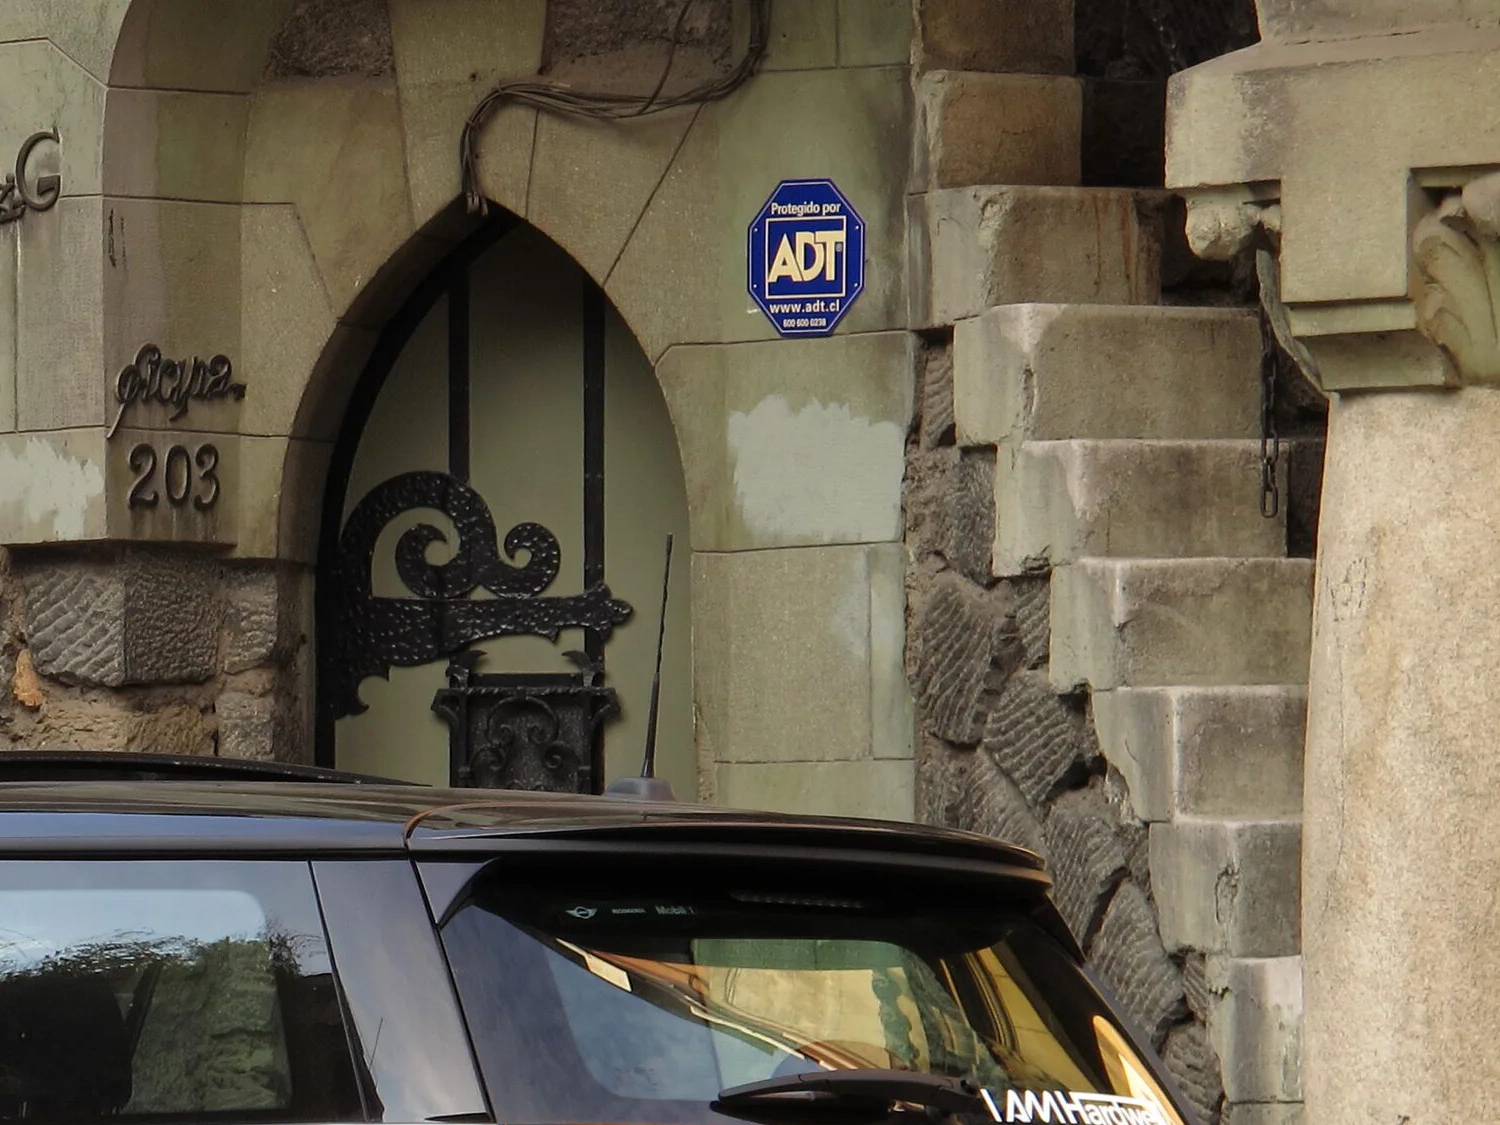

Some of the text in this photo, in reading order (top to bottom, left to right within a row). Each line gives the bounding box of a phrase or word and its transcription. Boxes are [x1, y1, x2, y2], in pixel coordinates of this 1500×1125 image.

[770, 201, 842, 217] Protegido por
[767, 230, 845, 283] ADT
[769, 299, 840, 314] www.adt.cl
[127, 443, 220, 511] 203
[979, 1088, 1003, 1124] I
[1005, 1089, 1067, 1125] AM
